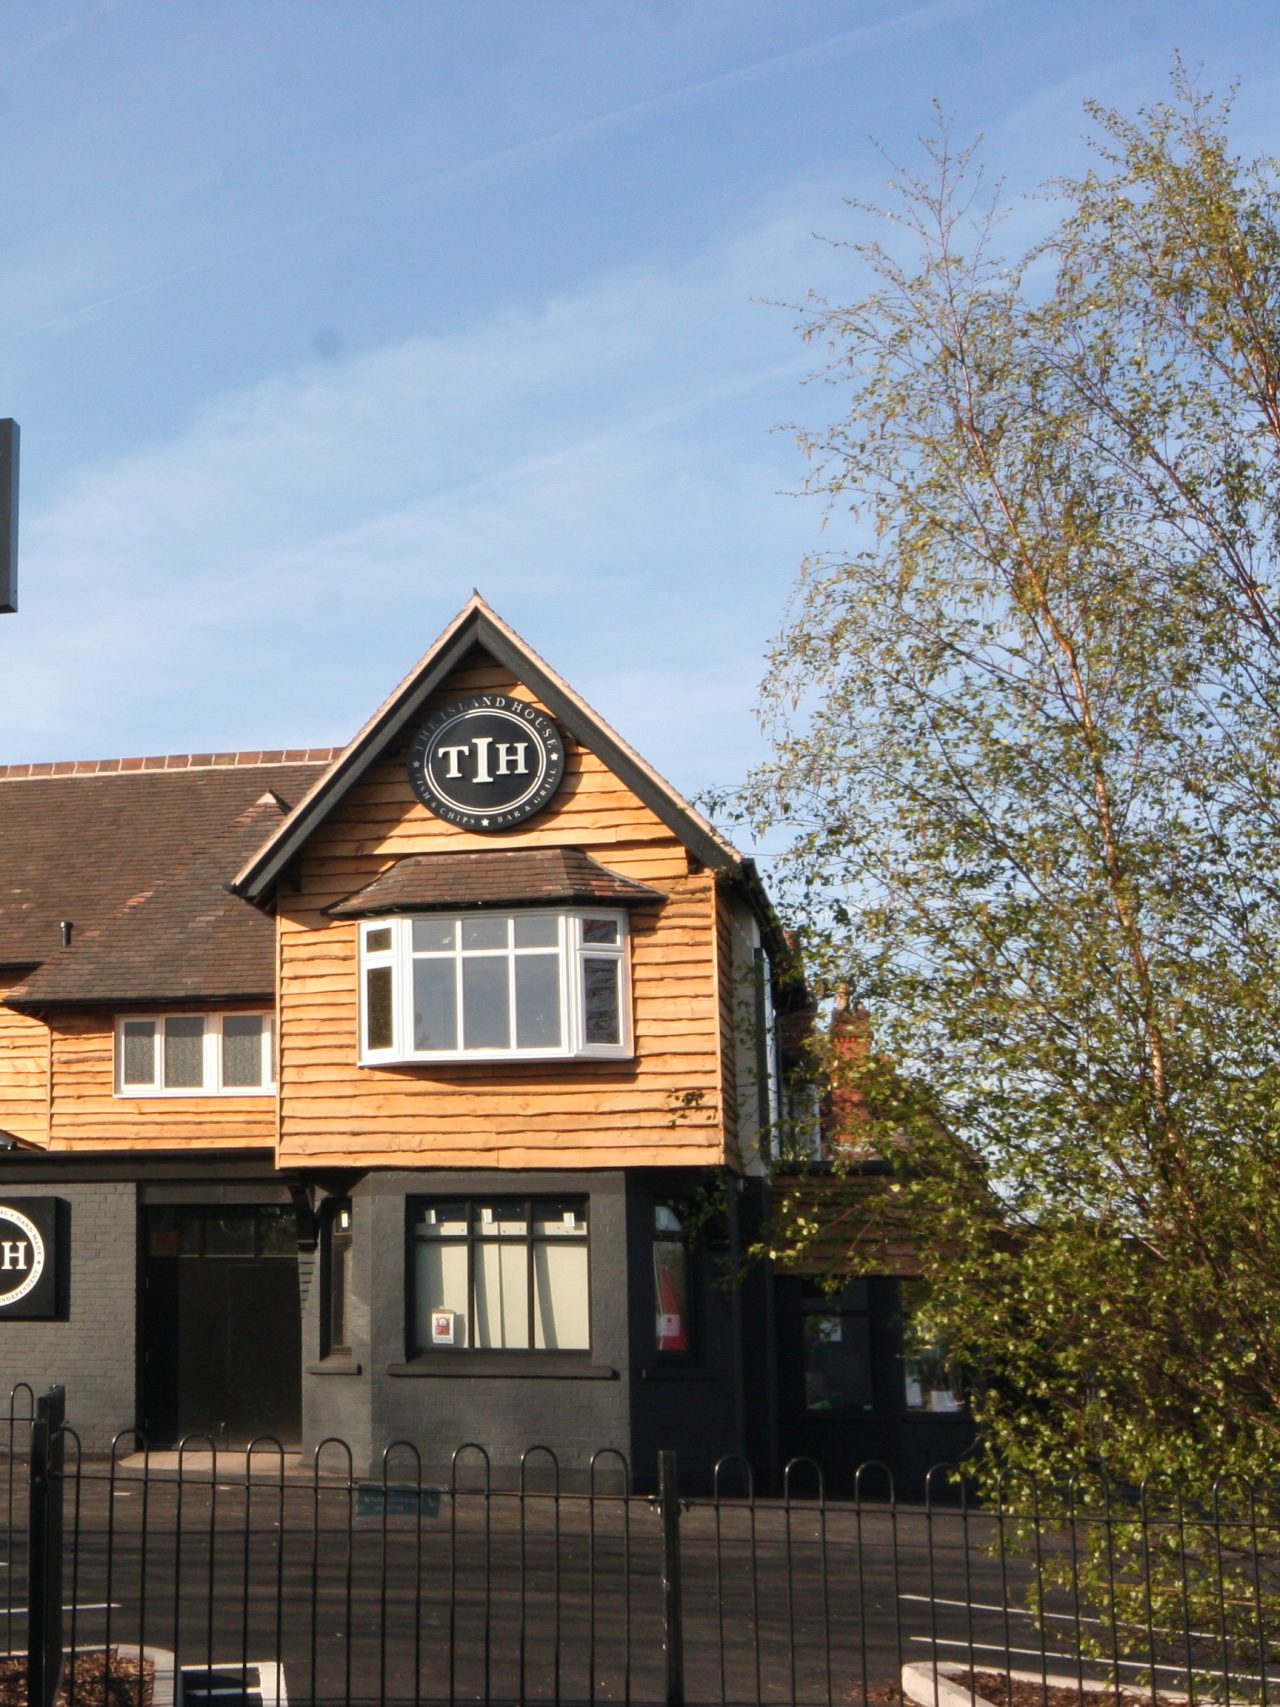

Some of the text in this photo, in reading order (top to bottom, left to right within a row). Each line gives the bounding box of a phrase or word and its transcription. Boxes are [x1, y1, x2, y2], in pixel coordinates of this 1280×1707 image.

[440, 695, 507, 721] ISLAND
[511, 701, 558, 749] HOUSE
[438, 737, 529, 784] TIH
[439, 806, 477, 825] CHIPS
[496, 810, 522, 824] BAR
[532, 767, 558, 805] GRILL
